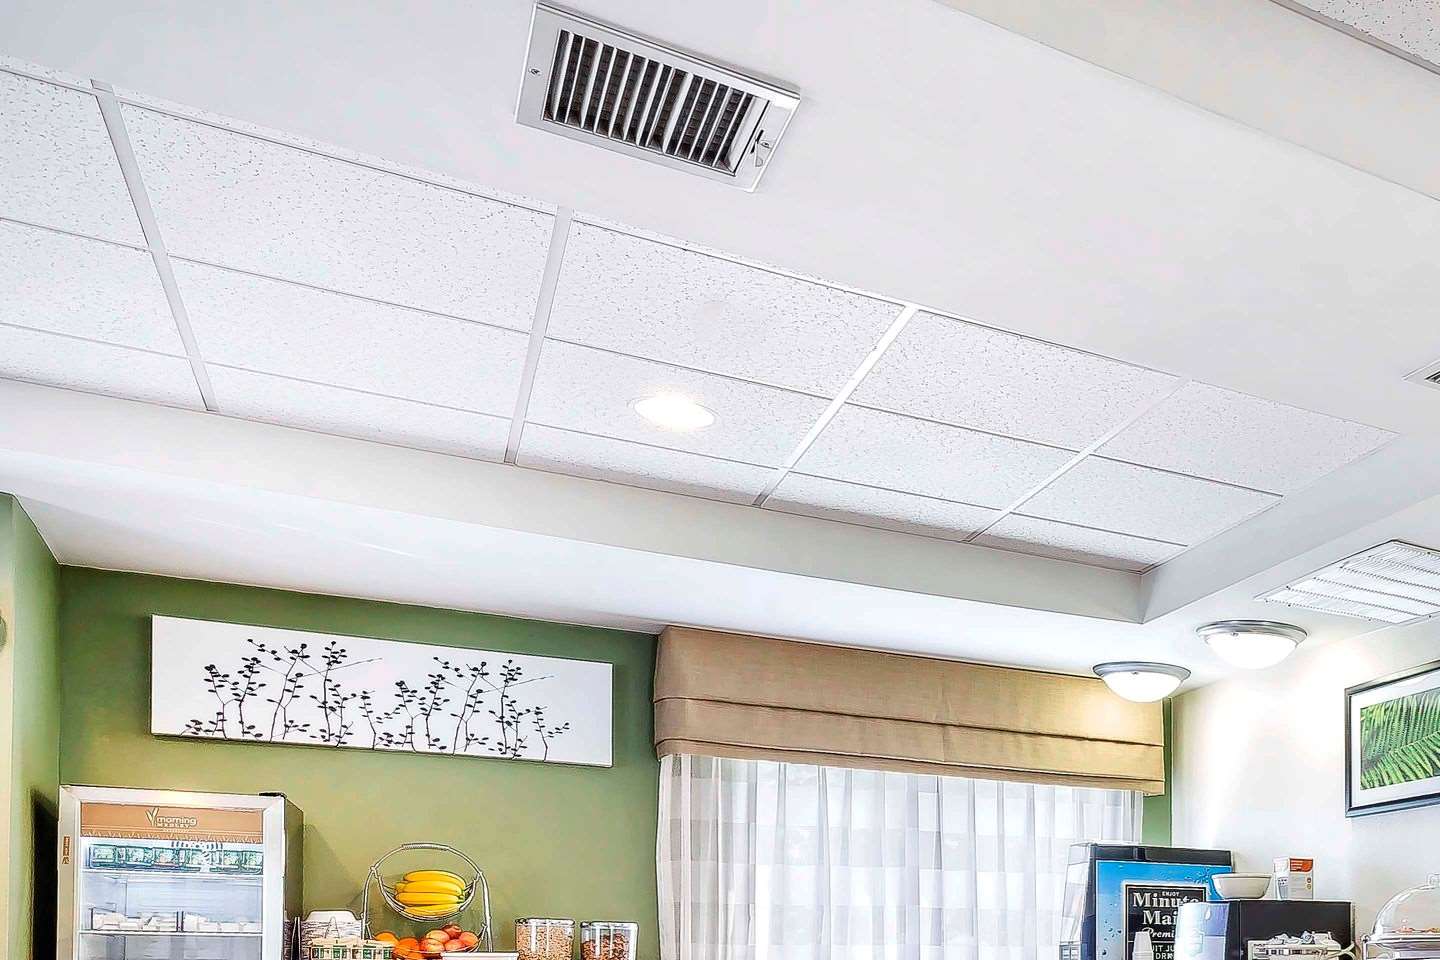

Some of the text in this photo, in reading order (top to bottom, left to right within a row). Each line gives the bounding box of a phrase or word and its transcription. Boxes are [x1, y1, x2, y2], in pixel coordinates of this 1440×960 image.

[157, 816, 198, 827] morning
[1142, 910, 1178, 925] Mai
[1142, 927, 1175, 938] Premi
